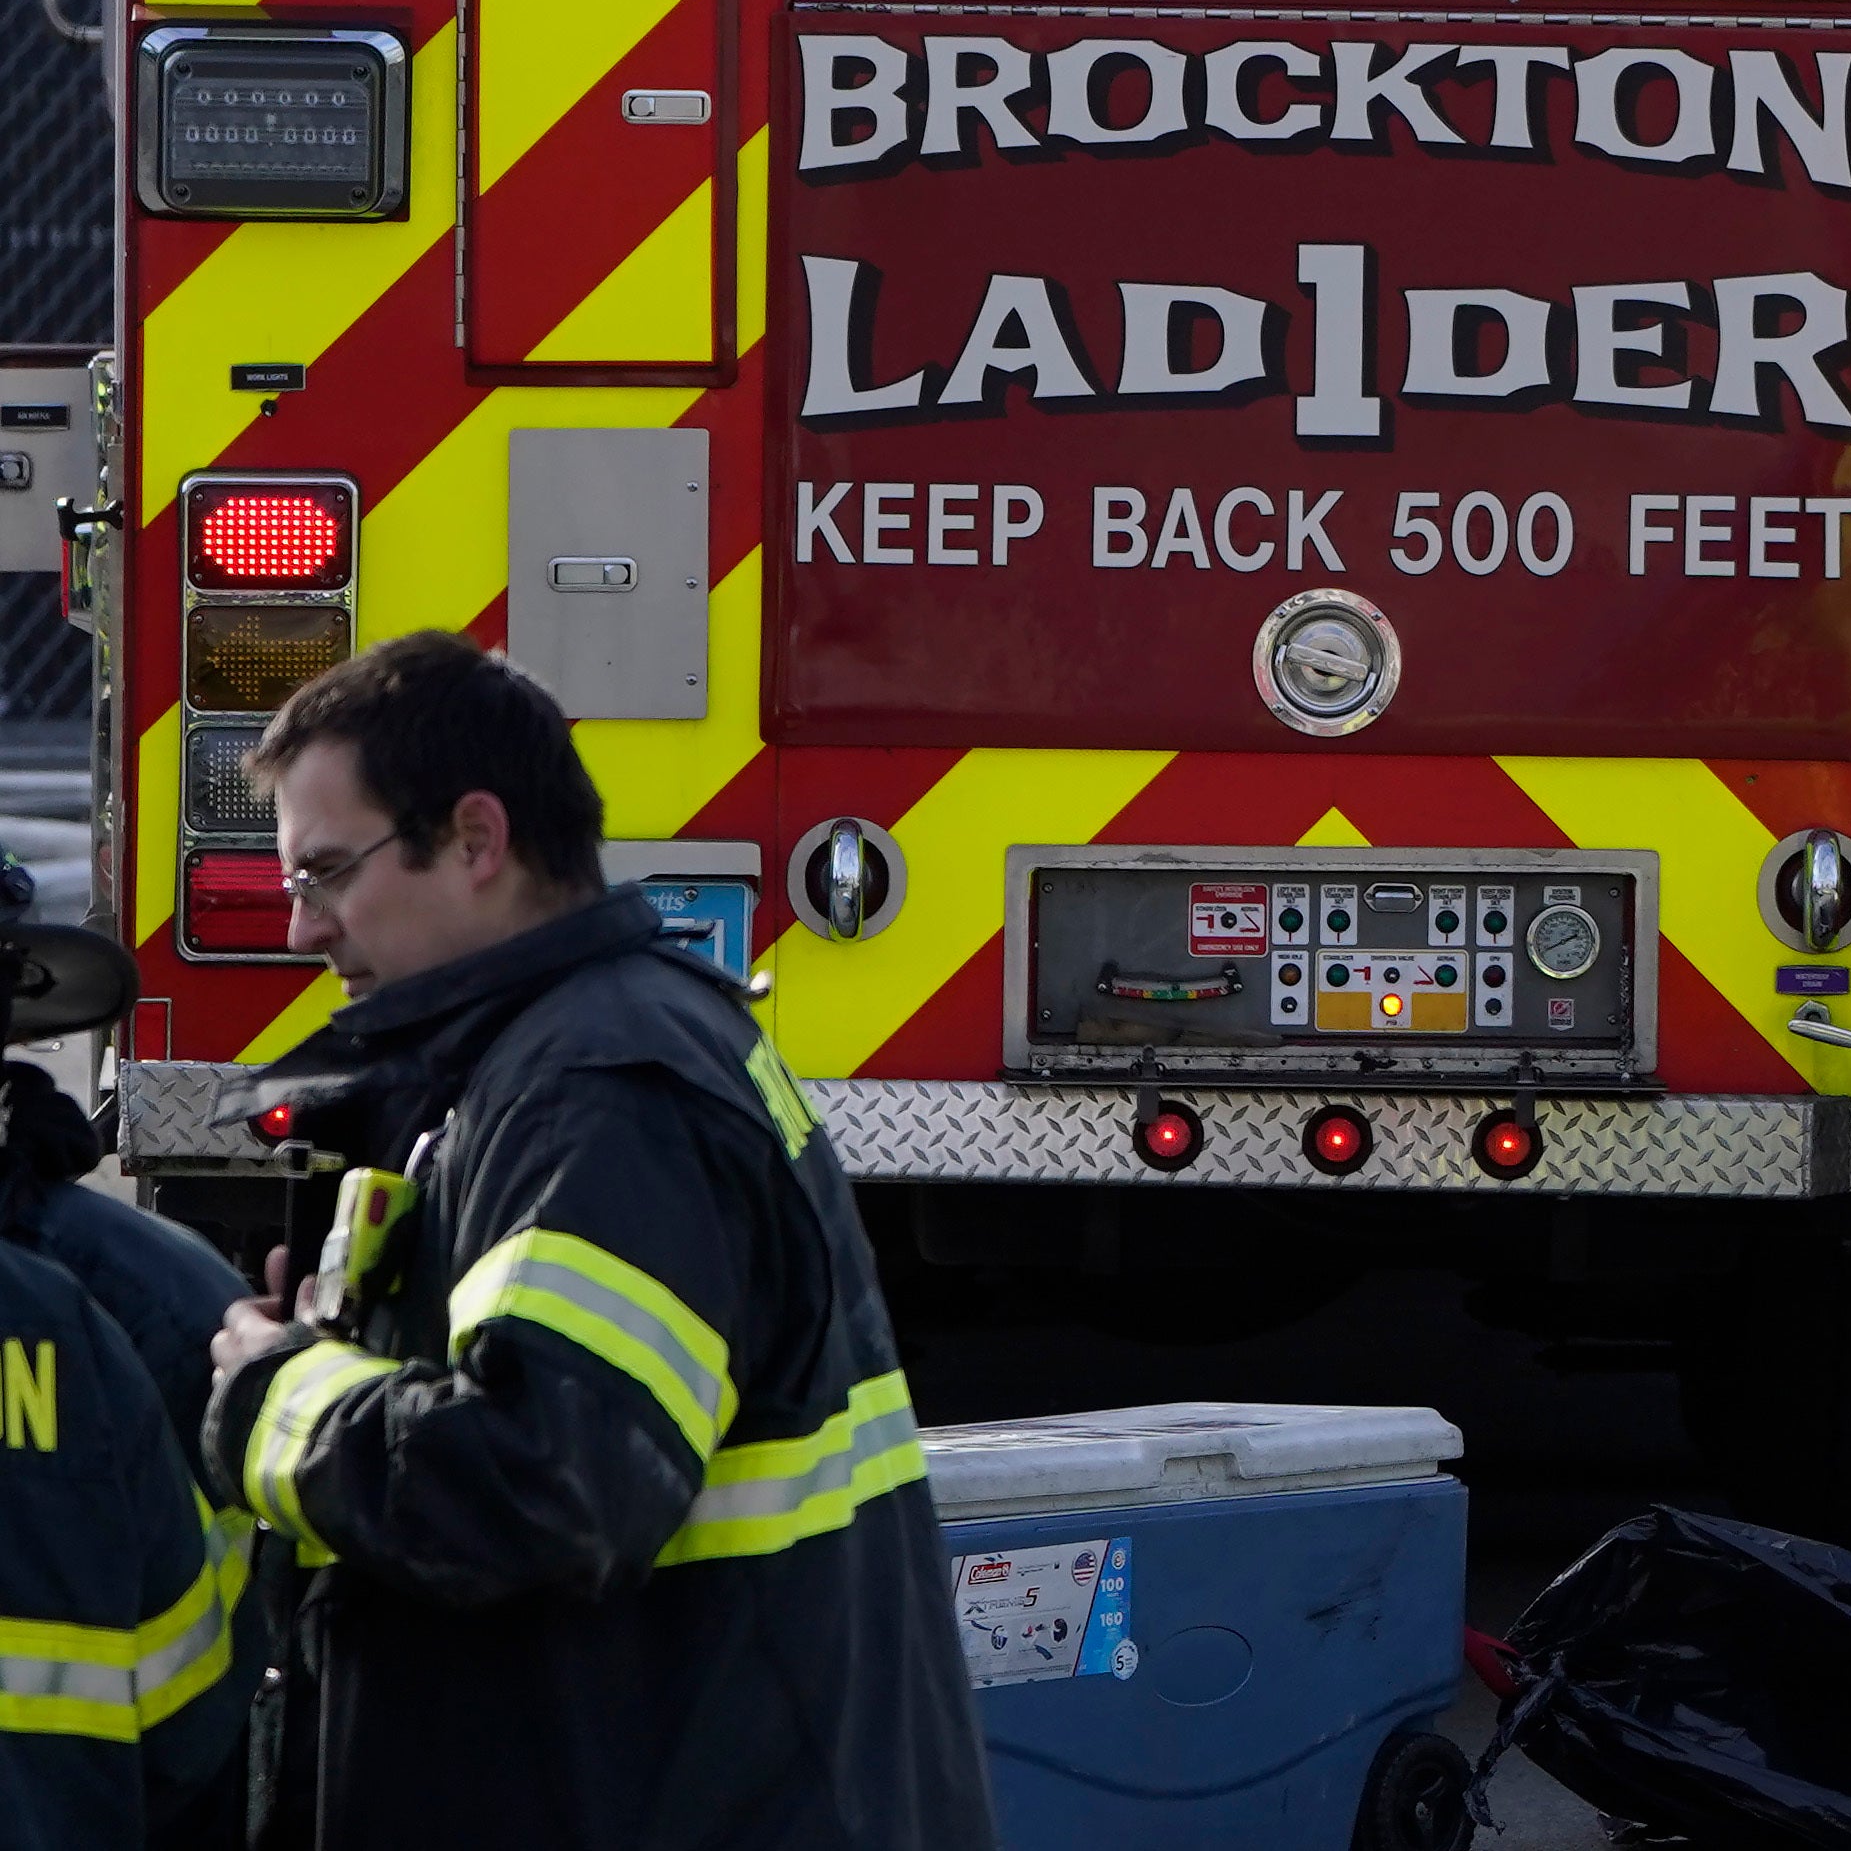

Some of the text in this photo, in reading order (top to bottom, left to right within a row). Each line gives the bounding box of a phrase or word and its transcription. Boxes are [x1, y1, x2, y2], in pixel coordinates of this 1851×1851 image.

[795, 479, 1045, 567] KEEP
[1092, 485, 1344, 575] BACK
[1387, 489, 1574, 578] 500
[1100, 1577, 1125, 1593] 100
[1023, 1586, 1041, 1608] 5
